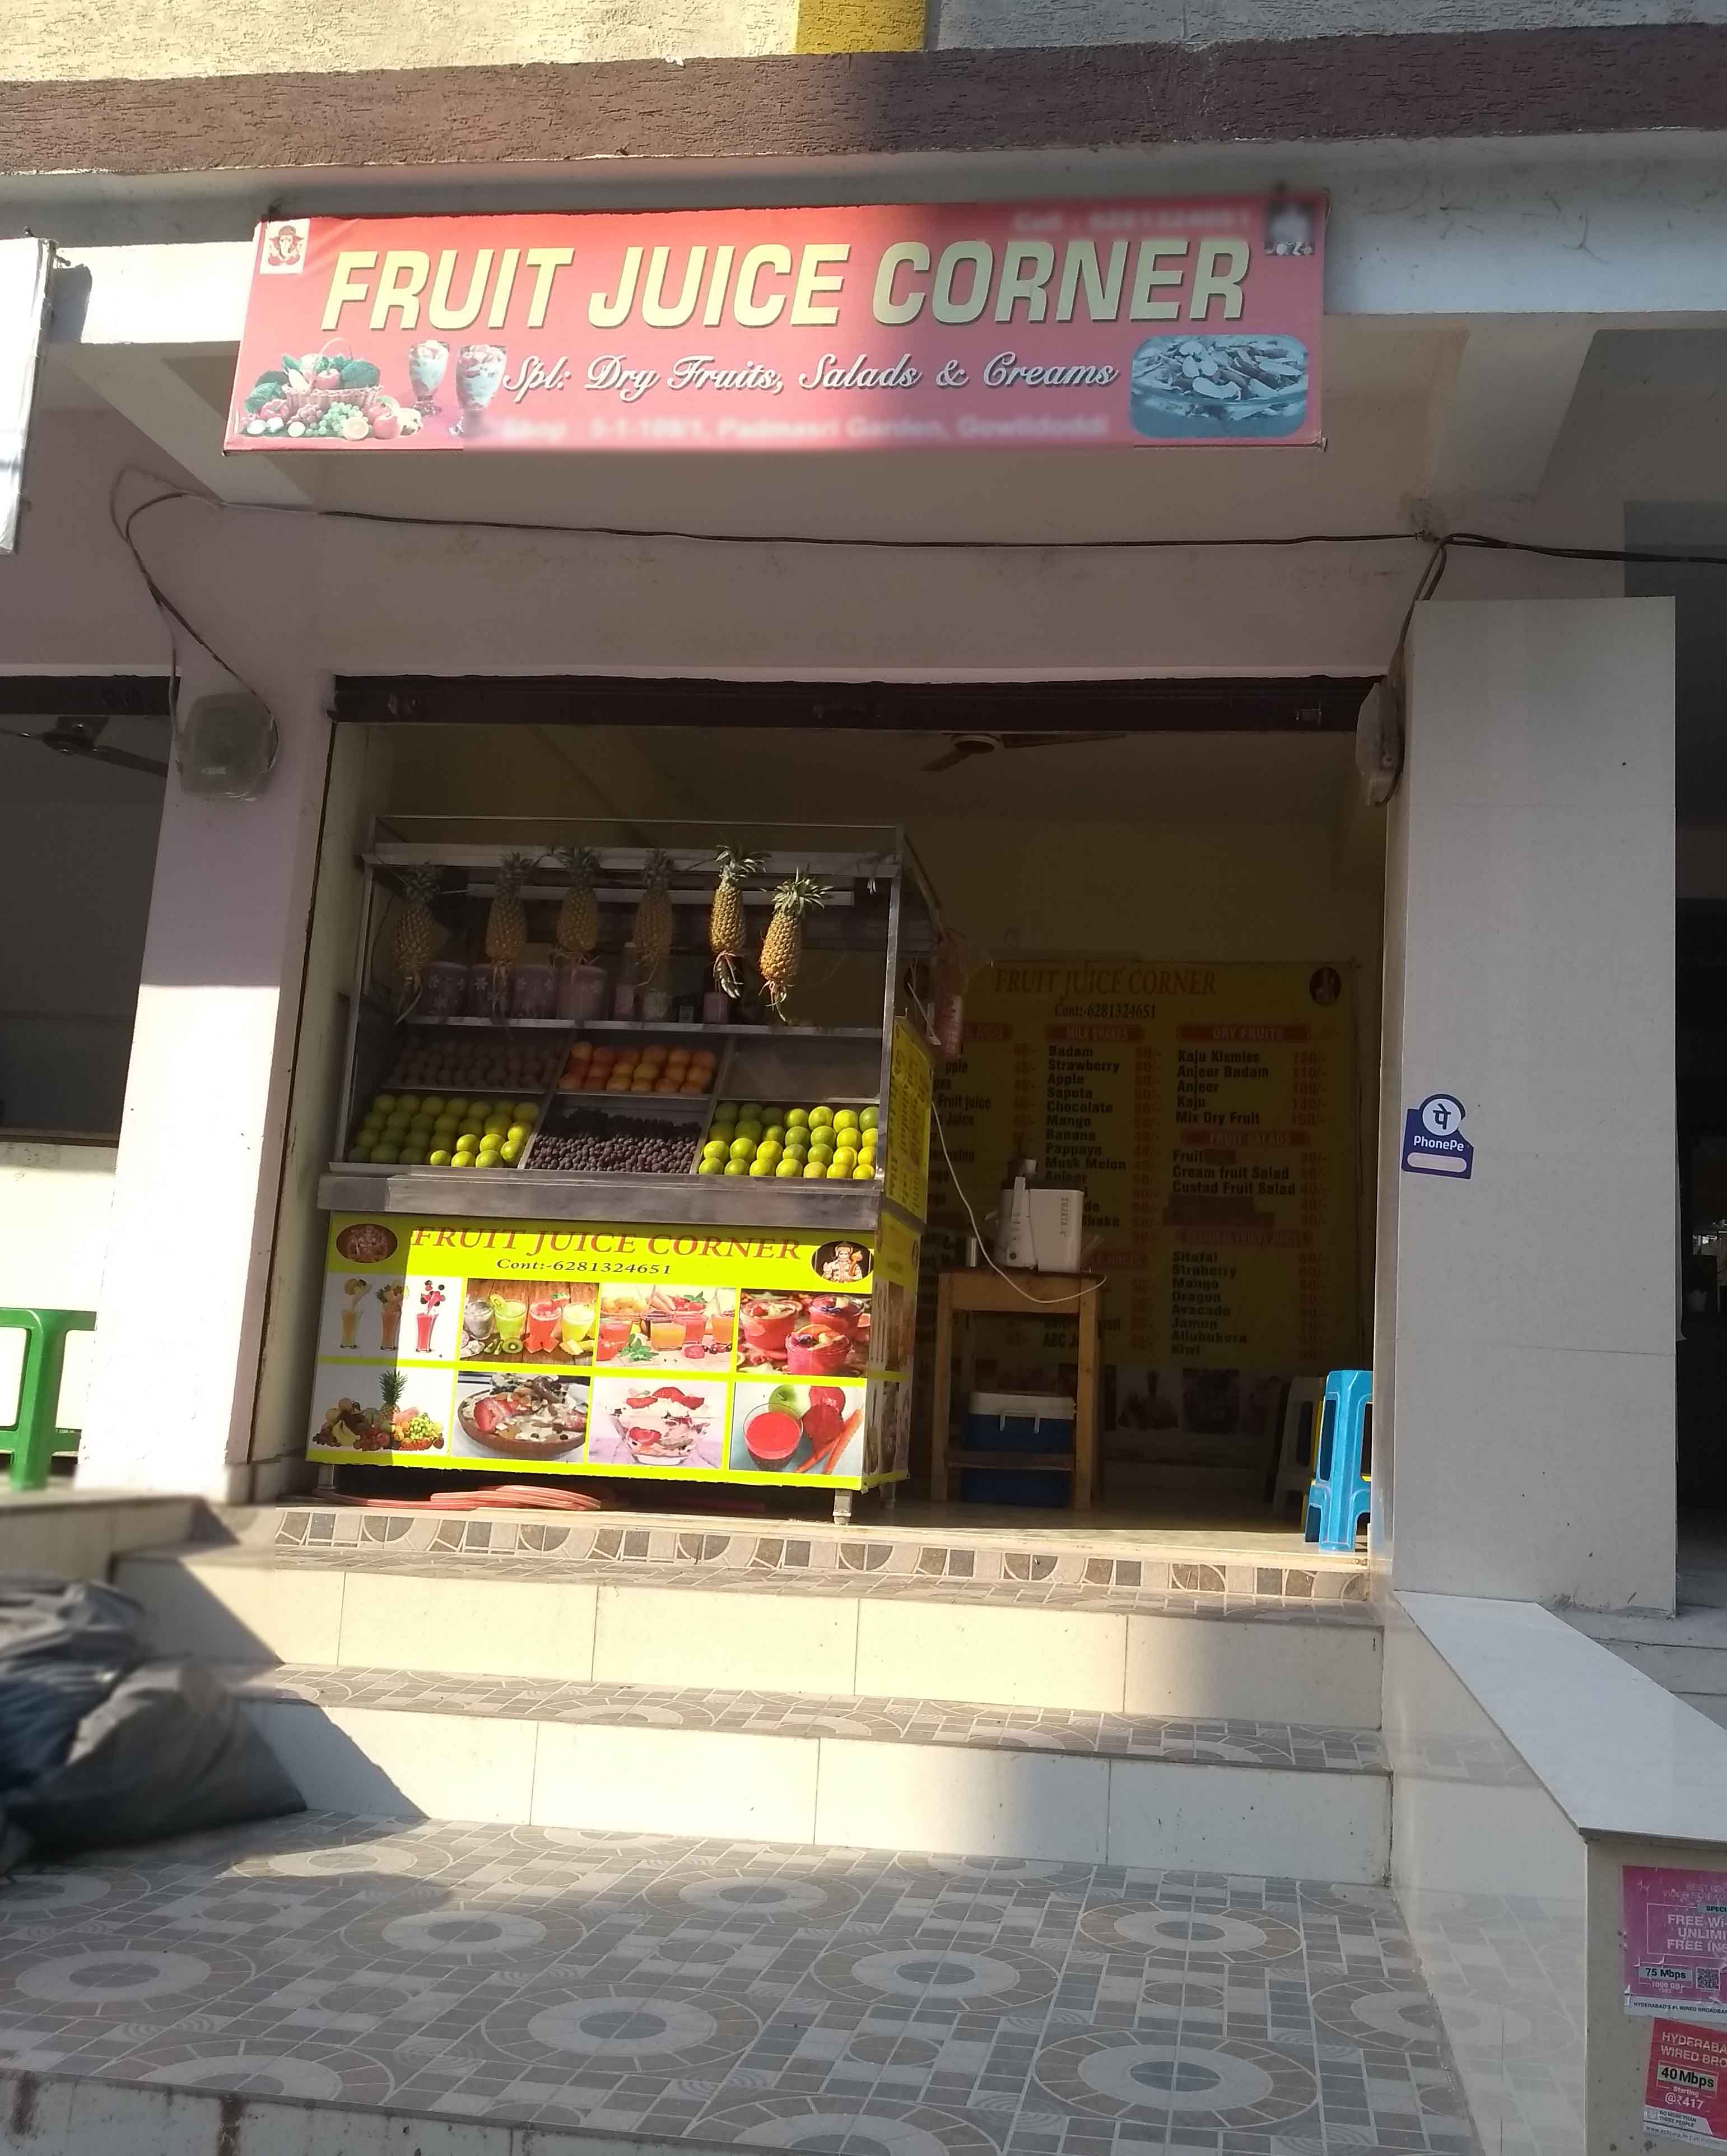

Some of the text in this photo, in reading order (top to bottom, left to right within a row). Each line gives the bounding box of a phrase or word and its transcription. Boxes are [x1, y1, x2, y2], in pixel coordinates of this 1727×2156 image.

[320, 241, 1250, 331] FRUIT JUICE CORNER
[503, 351, 1120, 403] Spl: Dry Fruits, Salads & Creams
[995, 968, 1217, 997] FRUIT JUICE CORNER
[1213, 1027, 1284, 1040] DRY FRUITS
[1048, 1045, 1093, 1057] Badam
[1177, 1049, 1206, 1065] Kaju
[1048, 1059, 1120, 1075] Strawberry
[1176, 1065, 1219, 1081] Anjeer
[1223, 1066, 1269, 1078] Badam
[1046, 1072, 1085, 1086] Apple
[1046, 1086, 1093, 1100] Sapota
[1176, 1080, 1219, 1095] Anjeer
[1046, 1100, 1114, 1113] Chocolate
[1177, 1095, 1206, 1110] Kaju
[1046, 1114, 1091, 1129] Mango
[1175, 1112, 1199, 1125] Mix
[1203, 1112, 1226, 1127] Dry
[1230, 1112, 1260, 1125] Fruit
[1045, 1128, 1096, 1141] Banana
[1045, 1142, 1102, 1156] Pappaya
[1413, 1135, 1464, 1151] PhonePe
[1045, 1156, 1081, 1169] Musk
[1085, 1158, 1126, 1170] Melon
[1172, 1149, 1203, 1163] Fruit
[1172, 1165, 1215, 1178] Cream
[1219, 1166, 1248, 1179] fruit
[1251, 1166, 1290, 1179] Salad
[1172, 1181, 1218, 1193] Custad
[1222, 1182, 1254, 1194] Fruit
[1258, 1182, 1296, 1196] Salad
[411, 1226, 802, 1260] FRUIT JUICE CORNER
[496, 1258, 672, 1275] Cont:-6281324651
[1172, 1277, 1219, 1290] Mango
[1172, 1290, 1222, 1304] Dragon
[1171, 1317, 1218, 1330] Jamun
[1668, 1914, 1704, 1926] FREE
[1667, 1939, 1703, 1951] FREE
[1646, 1968, 1687, 1980] 75 Mbps
[1661, 2045, 1700, 2062] WIRED
[1661, 2067, 1715, 2088] 40 Mbps
[1673, 2085, 1700, 2097] Starting
